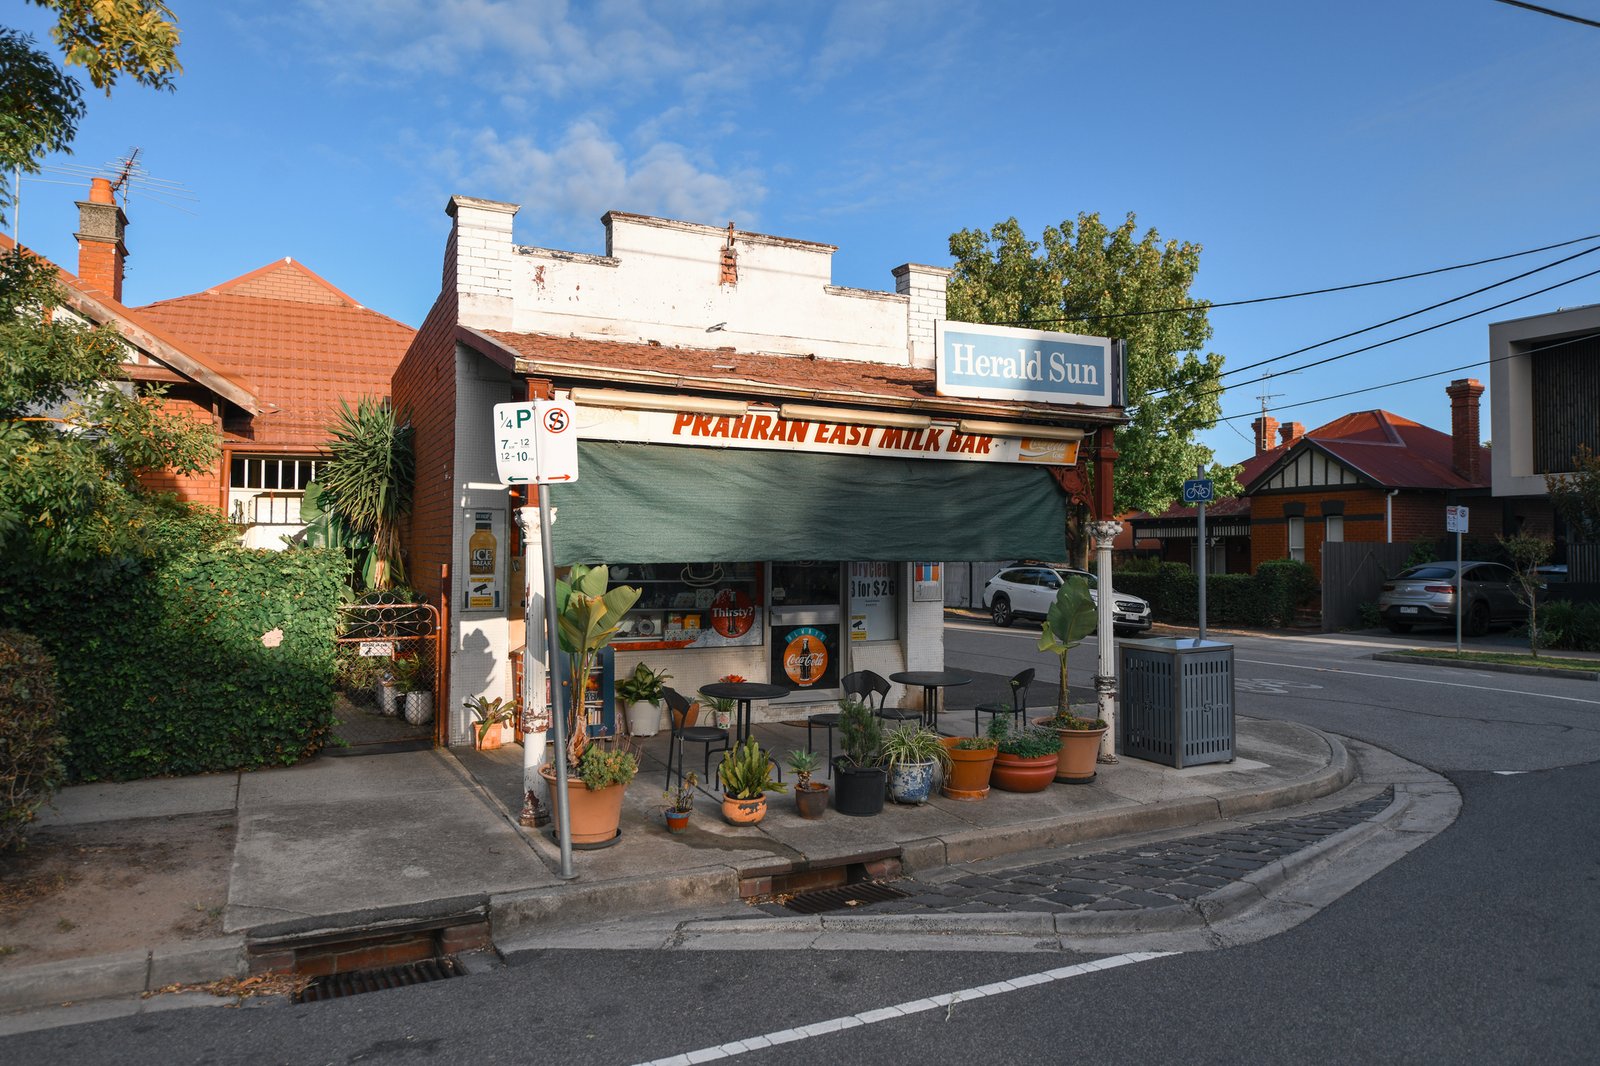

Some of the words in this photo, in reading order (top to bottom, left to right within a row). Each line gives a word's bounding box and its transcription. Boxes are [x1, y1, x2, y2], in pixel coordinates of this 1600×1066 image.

[951, 343, 1043, 381] Herald
[1049, 352, 1098, 385] Sun
[517, 409, 532, 429] P
[672, 411, 809, 443] PRAHRAN
[813, 422, 877, 447] EAST
[878, 426, 944, 451] MILK
[946, 428, 993, 454] BAR
[473, 549, 493, 561] ICE
[858, 580, 871, 597] for
[711, 606, 754, 619] Thirsty?
